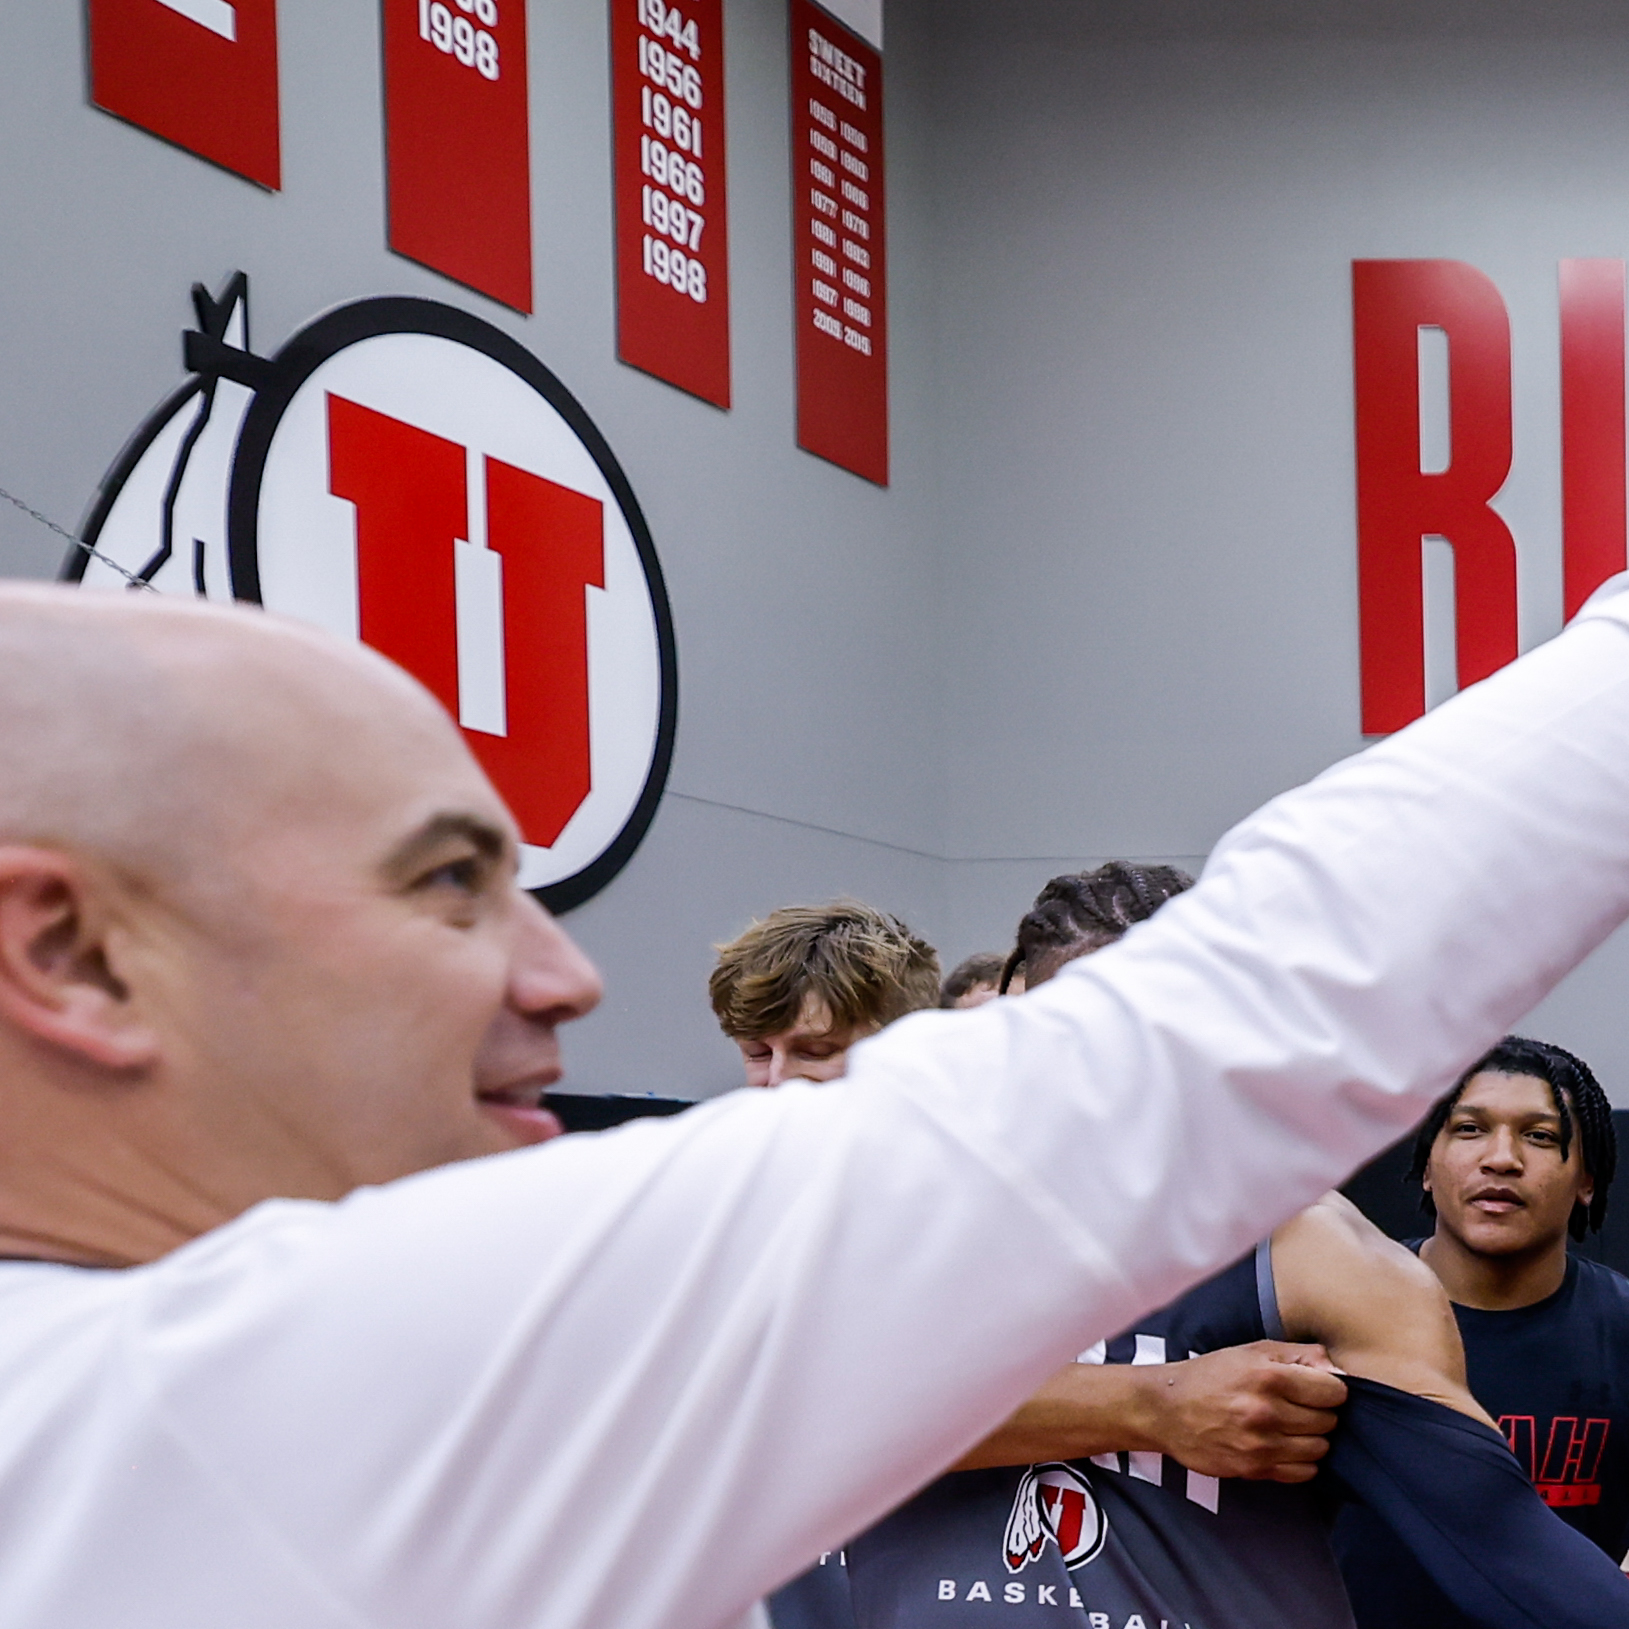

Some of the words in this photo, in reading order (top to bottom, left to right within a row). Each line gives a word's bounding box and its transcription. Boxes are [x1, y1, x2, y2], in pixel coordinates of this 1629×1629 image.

[418, 0, 500, 81] 1998
[638, 0, 701, 61] 1944
[639, 34, 702, 109] 1956
[641, 85, 702, 158] 1961
[641, 134, 704, 206] 1966
[642, 184, 704, 251] 1997
[643, 233, 706, 303] 1998
